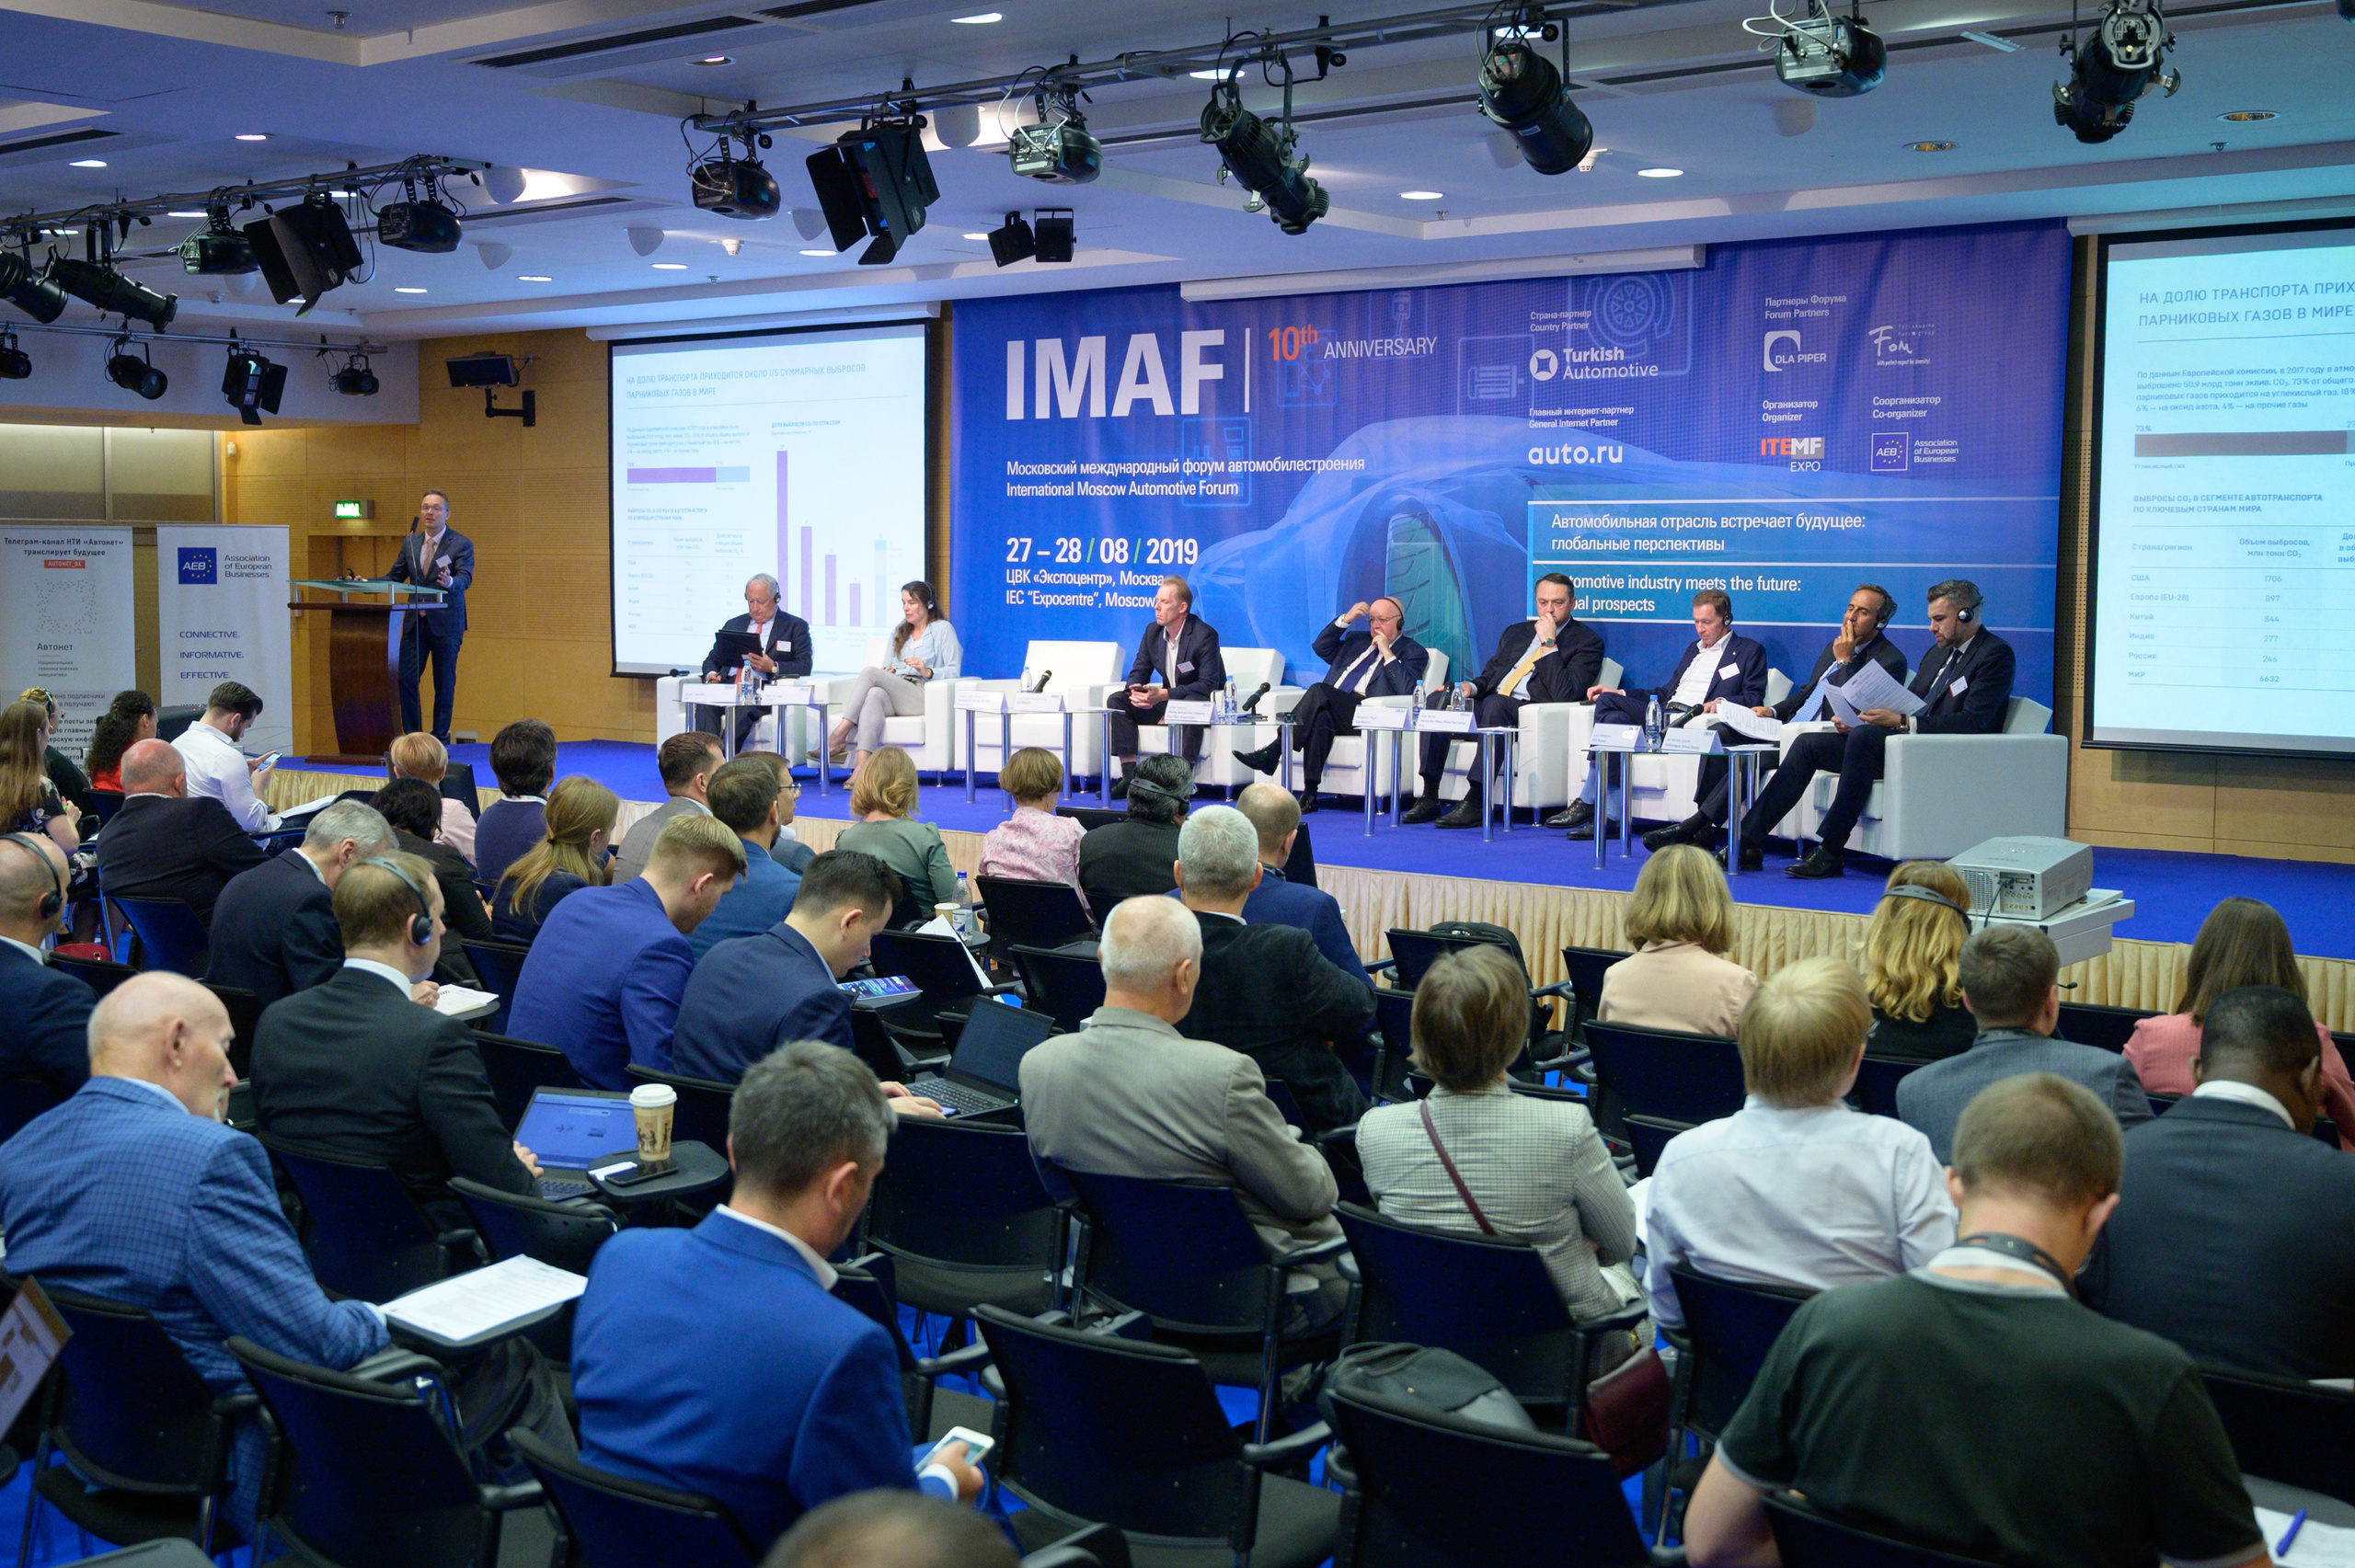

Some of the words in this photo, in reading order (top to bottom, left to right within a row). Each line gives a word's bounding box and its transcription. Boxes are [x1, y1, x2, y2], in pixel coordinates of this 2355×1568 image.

[2140, 292, 2158, 303] НА
[2163, 290, 2206, 304] ДОЛЮ
[2212, 284, 2309, 300] ТРАНСПОРТА
[1765, 296, 1808, 308] Партнеры
[1810, 294, 1846, 305] Форума
[1531, 310, 1591, 321] Страна-партнер
[1765, 311, 1791, 319] Forum
[1794, 308, 1829, 318] Partners
[2139, 311, 2239, 326] ПАРНИКОВЫХ
[2245, 308, 2292, 322] ГАЗОВ
[2298, 307, 2305, 319] В
[2313, 305, 2353, 318] МИРЕ
[1531, 324, 1559, 332] Country
[1562, 322, 1589, 330] Partner
[1269, 325, 1317, 361] 10th
[1324, 337, 1437, 359] ANNIVERSARY
[1563, 347, 1625, 362] Turkish
[1775, 354, 1794, 364] DLA
[1798, 353, 1826, 362] PIPER
[626, 376, 635, 384] НА
[637, 375, 655, 384] ДОЛЮ
[658, 373, 698, 383] ТРАНСПОРТА
[700, 371, 743, 381] ПРИХОДИТСЯ
[746, 370, 767, 379] ОКОЛО
[780, 367, 824, 376] СУММАРНЫХ
[827, 364, 866, 373] ВЫБРОСОВ
[1006, 329, 1224, 420] IMAF
[1563, 363, 1658, 380] Automotive
[2149, 371, 2179, 379] данным
[2182, 368, 2234, 379] Европейской
[2305, 367, 2325, 376] году
[2137, 381, 2181, 390] выброшено
[2201, 381, 2223, 389] млрд
[2323, 377, 2353, 385] общего
[626, 389, 670, 398] ПАРНИКОВЫХ
[672, 388, 691, 396] ГАЗОВ
[699, 387, 717, 395] МИРЕ
[2137, 393, 2184, 401] парниковых
[2210, 390, 2257, 399] приходится
[2272, 388, 2321, 398] углекислый
[1763, 400, 1818, 410] Организатор
[1873, 396, 1941, 406] Соорганизатор
[2170, 403, 2193, 412] оксид
[2257, 401, 2285, 410] прочие
[1529, 407, 1562, 416] Главный
[1564, 406, 1634, 417] интернет-партнер
[1873, 409, 1927, 419] Co-organizer
[1529, 419, 1557, 428] General
[1763, 413, 1802, 423] Organizer
[1528, 443, 1623, 464] auto.ru
[1876, 448, 1897, 456] AEB
[1924, 448, 1959, 456] European
[1007, 461, 1076, 475] Московский
[1080, 459, 1178, 476] международный
[1183, 459, 1223, 475] форум
[1228, 456, 1365, 476] автомобилестроения
[1790, 461, 1821, 472] EXPO
[1006, 482, 1074, 497] International
[1077, 482, 1126, 496] Moscow
[1129, 481, 1196, 496] Automotive
[1200, 480, 1238, 496] Forum
[1552, 514, 1657, 528] Автомобильная
[1661, 517, 1717, 531] отрасль
[1721, 517, 1793, 531] встречает
[1796, 512, 1866, 531] будущее:
[1552, 536, 1630, 550] глобальные
[1635, 539, 1724, 554] перспективы
[2132, 543, 2192, 552] Страна/регион
[1006, 538, 1032, 563] 27
[1055, 538, 1082, 563] 28
[1100, 538, 1128, 564] 08
[1146, 538, 1198, 564] 2019
[183, 562, 206, 570] AEB
[1006, 569, 1030, 586] ЦВК
[1033, 569, 1115, 587] «Экспоцентр»,
[1120, 571, 1164, 586] Москва
[1628, 575, 1682, 592] industry
[1686, 578, 1726, 590] meets
[1730, 576, 1752, 590] the
[1757, 576, 1800, 591] future:
[1006, 590, 1024, 604] IEC
[2161, 593, 2188, 601] (EU-28)
[1592, 597, 1655, 613] prospects
[2130, 612, 2154, 621] Китай
[37, 643, 73, 651] Автонет
[2129, 652, 2156, 660] Россия
